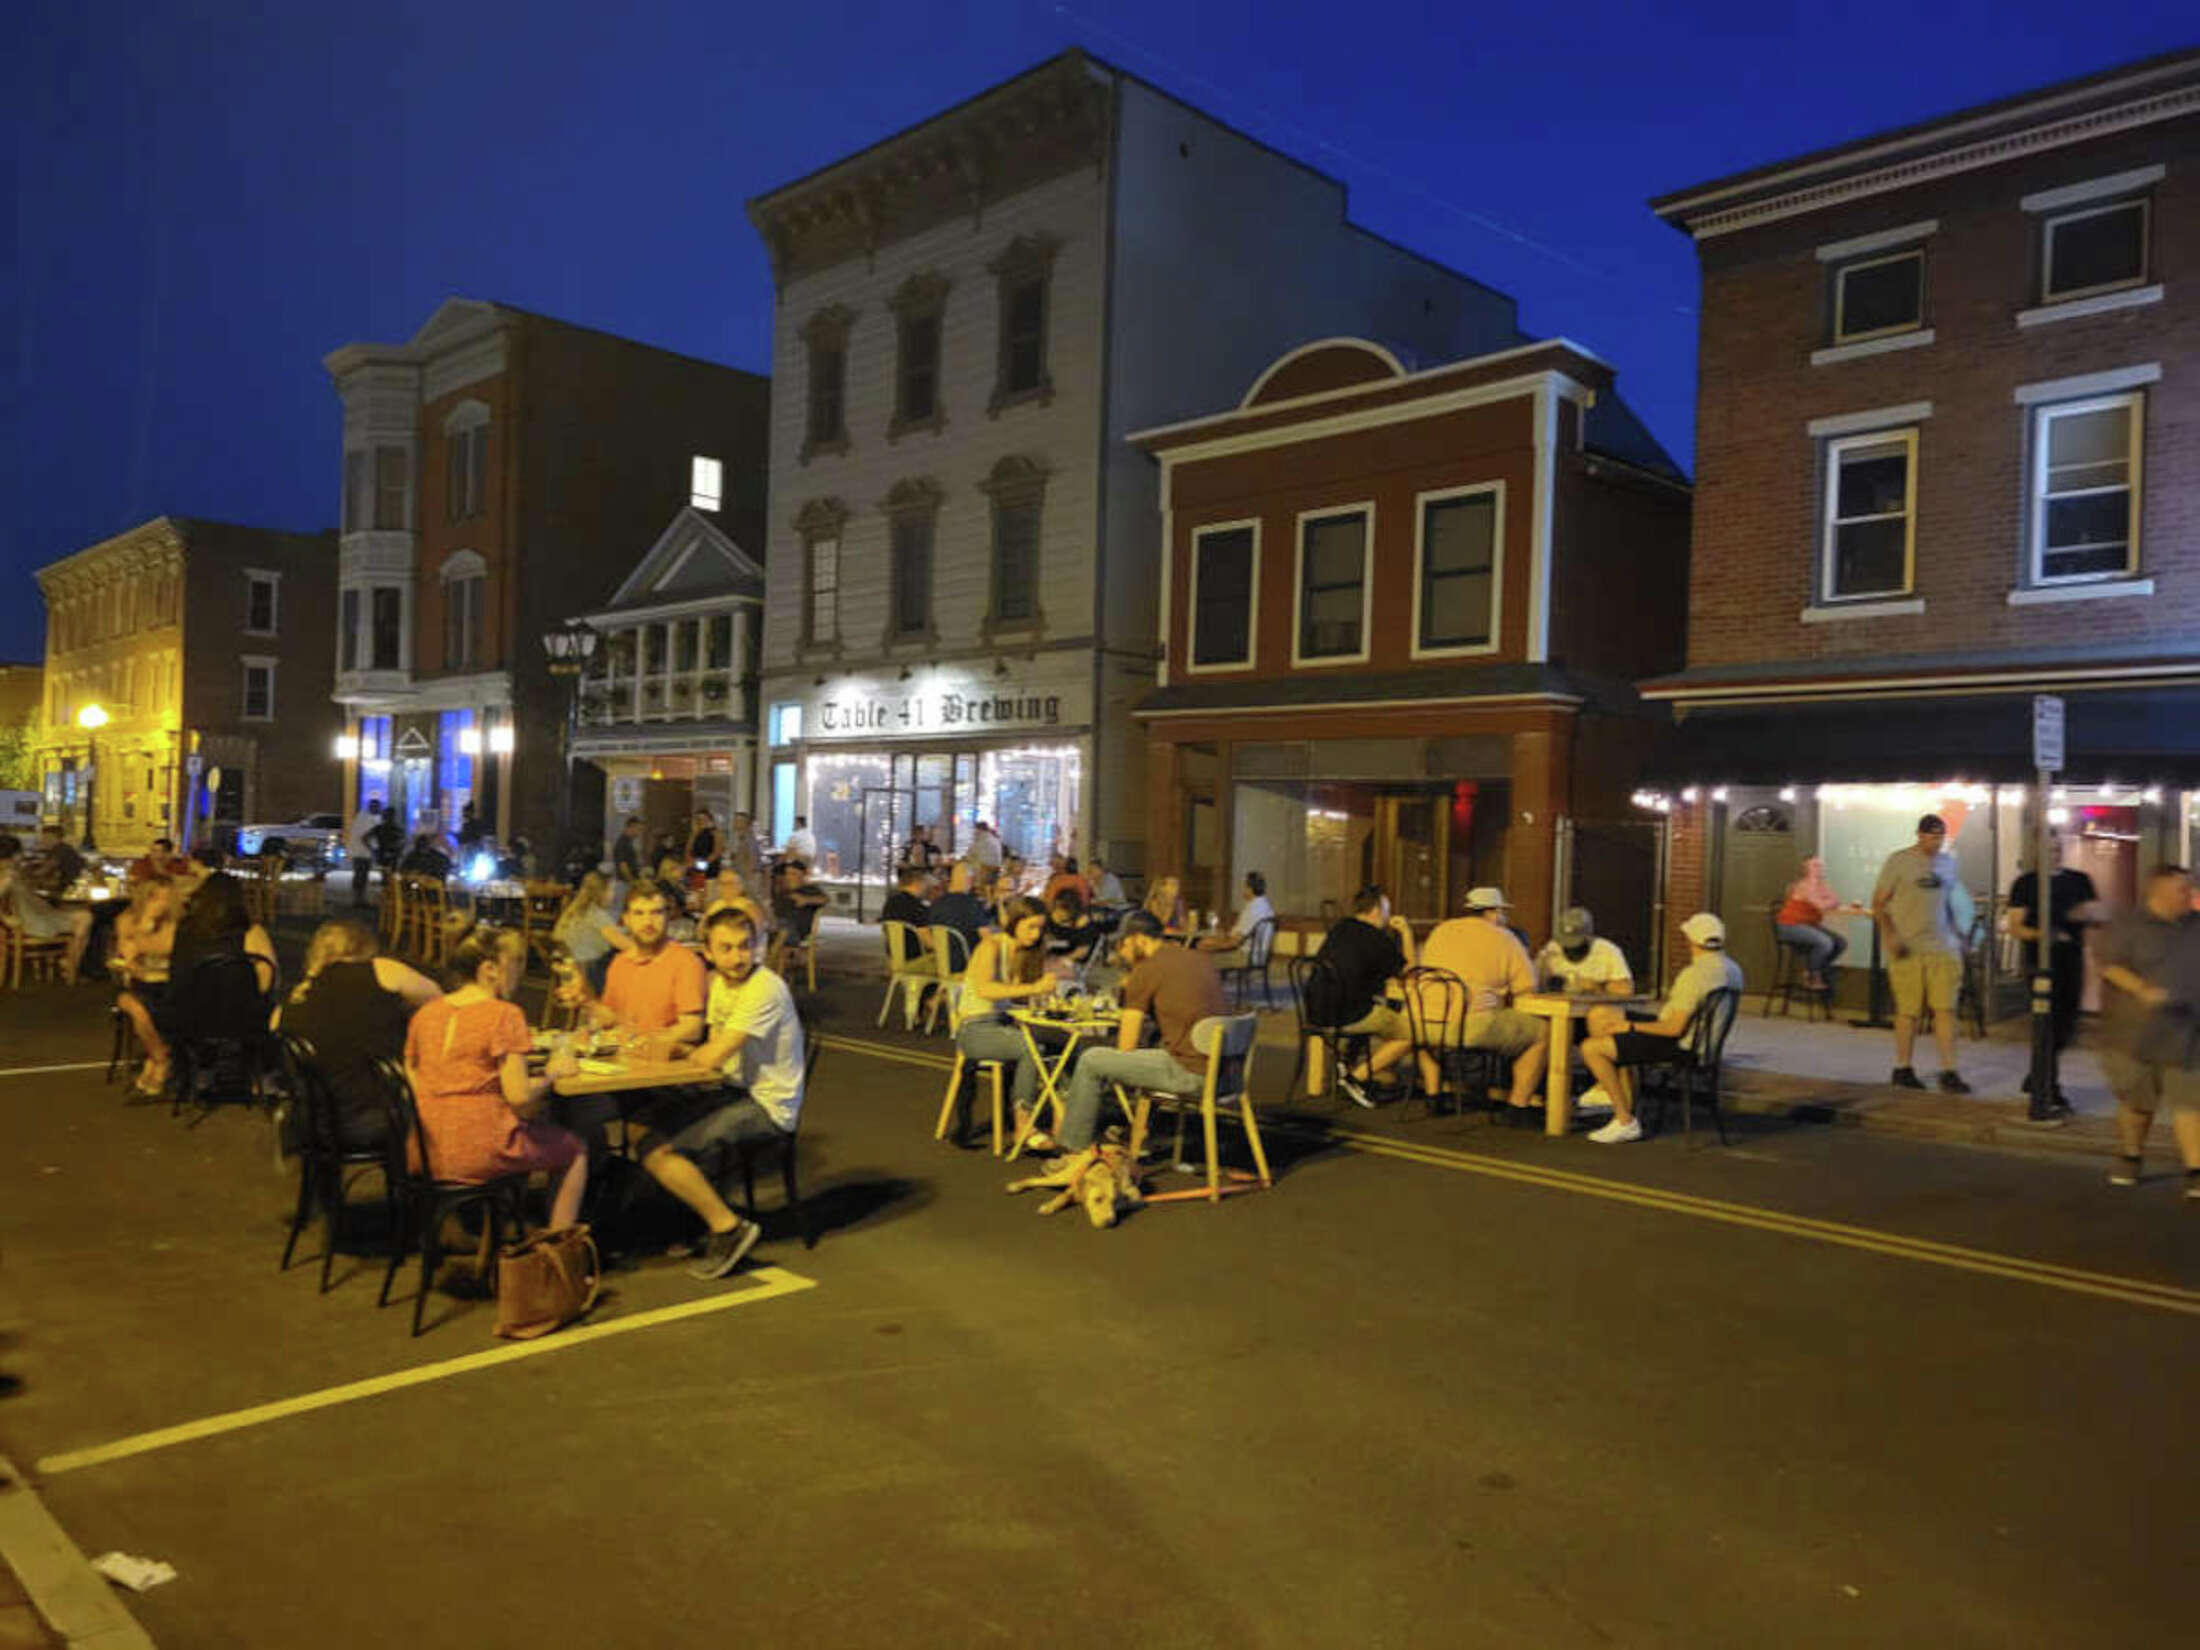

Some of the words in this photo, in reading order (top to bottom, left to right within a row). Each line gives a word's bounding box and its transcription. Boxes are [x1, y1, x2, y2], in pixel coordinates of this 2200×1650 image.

[822, 702, 888, 730] Table
[898, 699, 925, 727] 41
[941, 694, 1061, 724] Brewing
